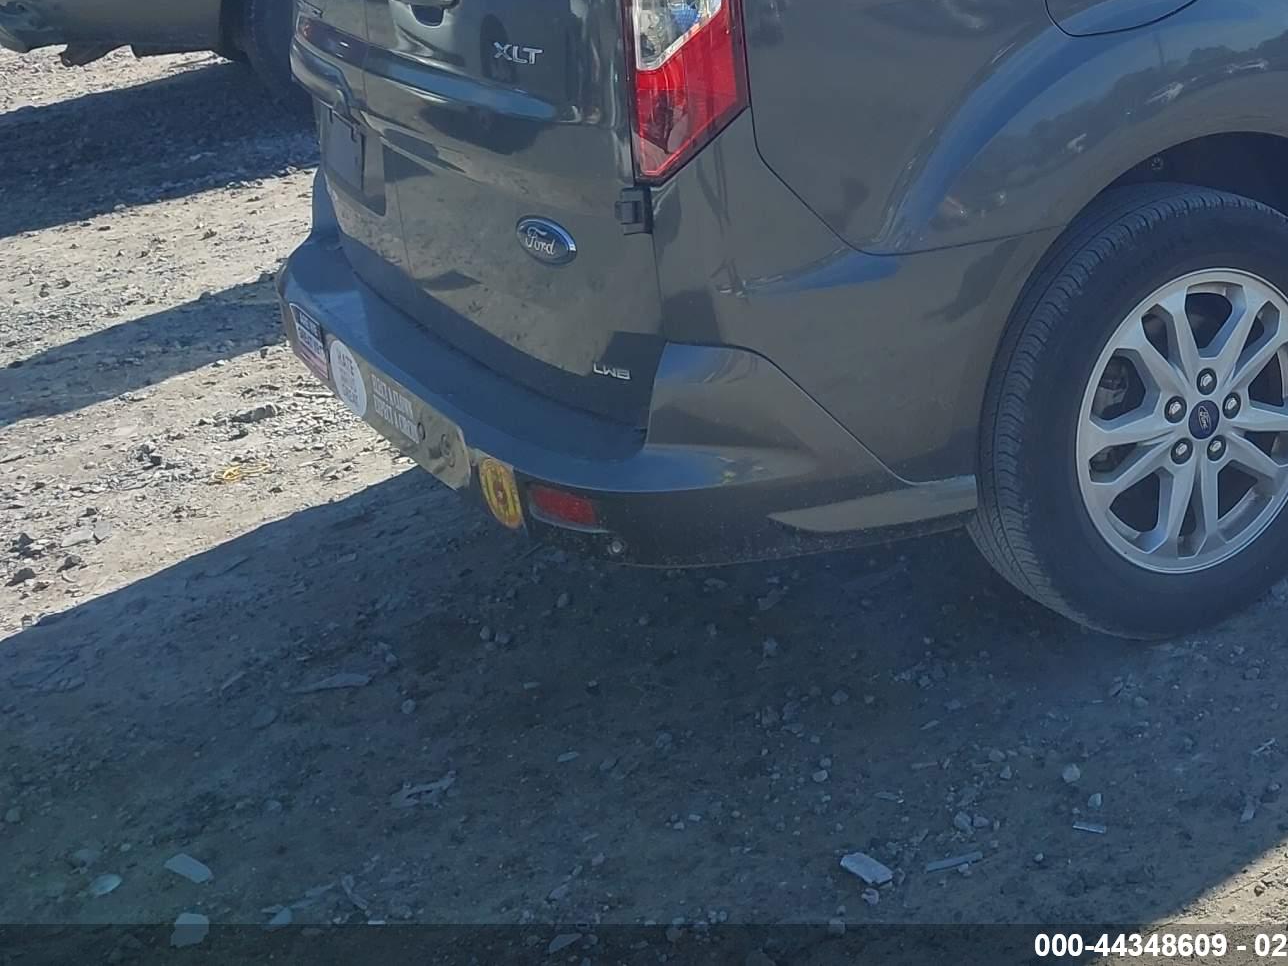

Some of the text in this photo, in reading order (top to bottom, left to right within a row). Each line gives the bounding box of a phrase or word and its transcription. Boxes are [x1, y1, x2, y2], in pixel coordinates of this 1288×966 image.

[493, 41, 543, 65] XLT
[524, 226, 557, 255] Ford
[593, 362, 631, 380] LWB
